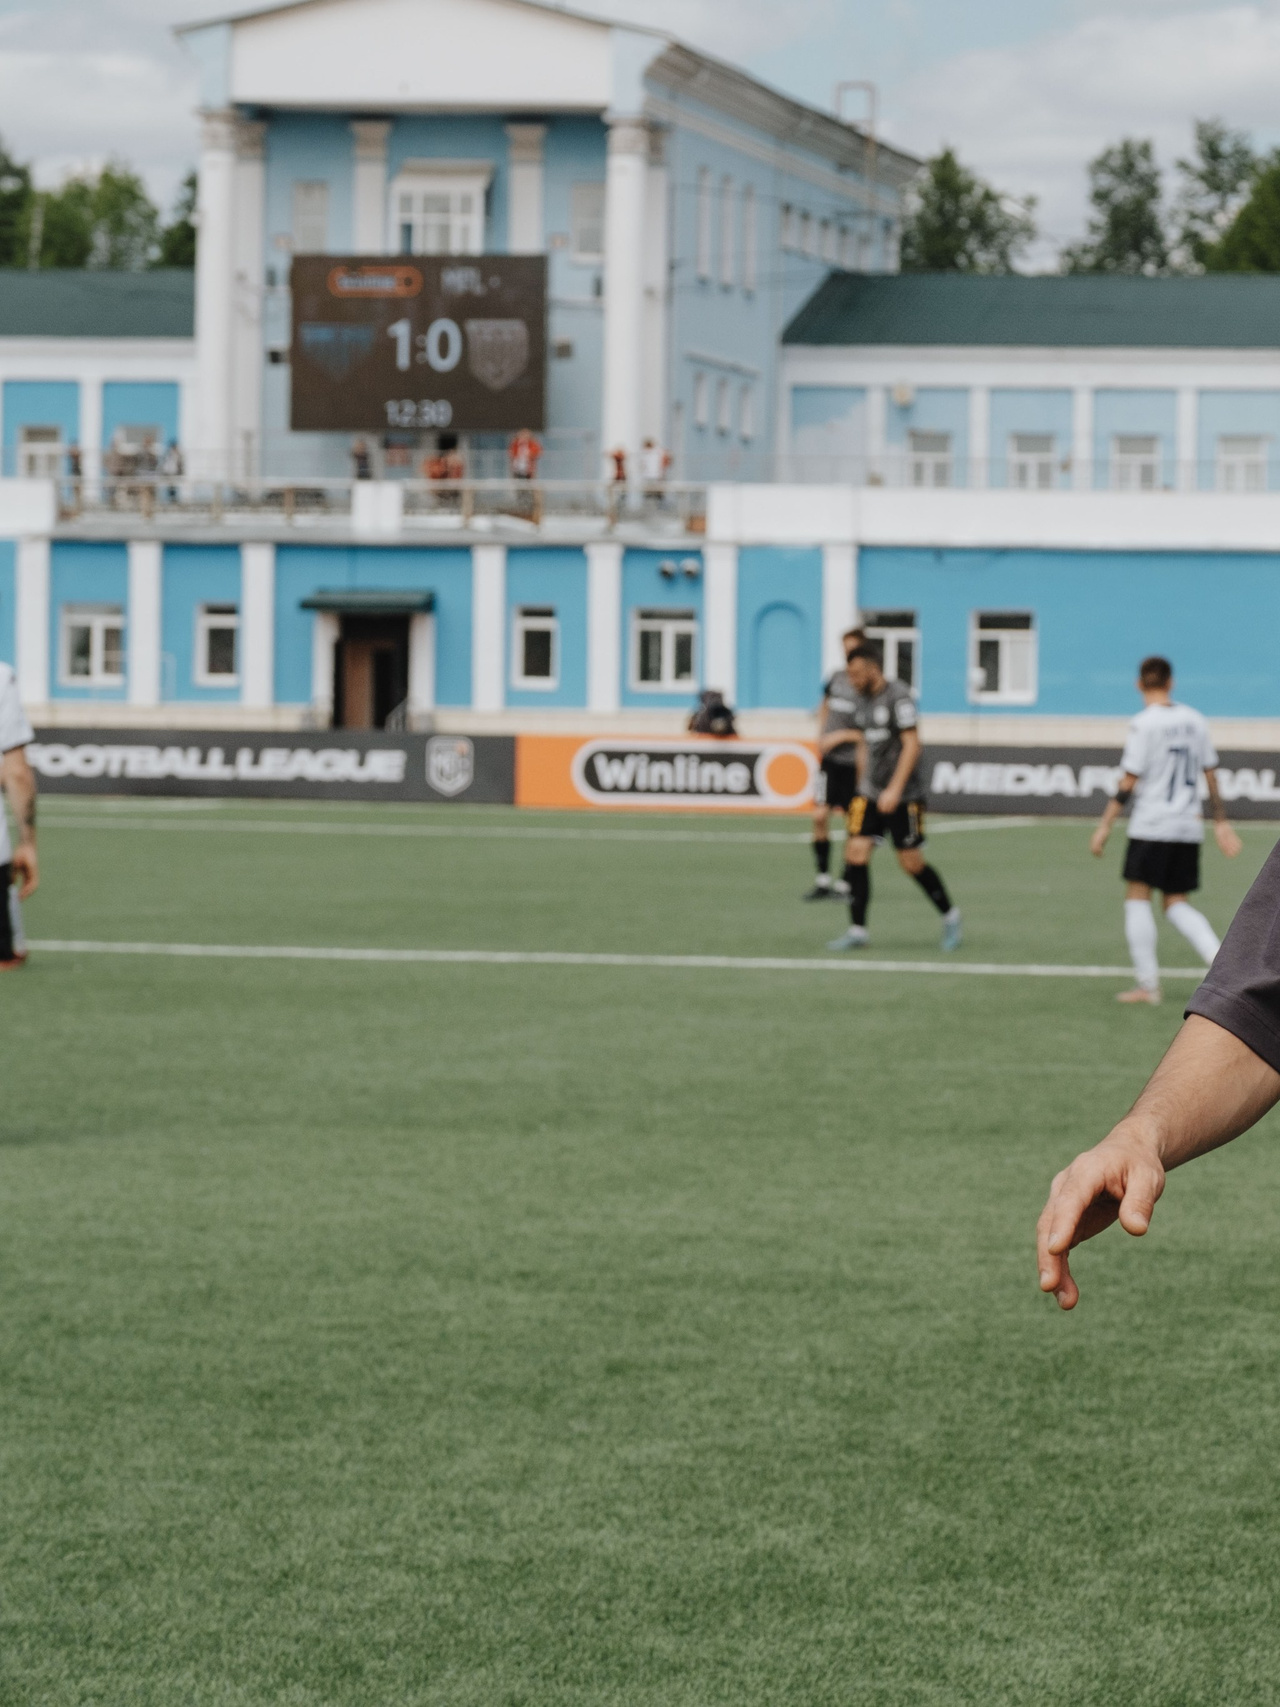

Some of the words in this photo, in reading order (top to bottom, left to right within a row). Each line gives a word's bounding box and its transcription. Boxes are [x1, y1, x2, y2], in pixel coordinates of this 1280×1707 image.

[236, 748, 407, 783] LEAGUE
[593, 754, 751, 794] Winline
[931, 761, 1077, 797] MEDIA
